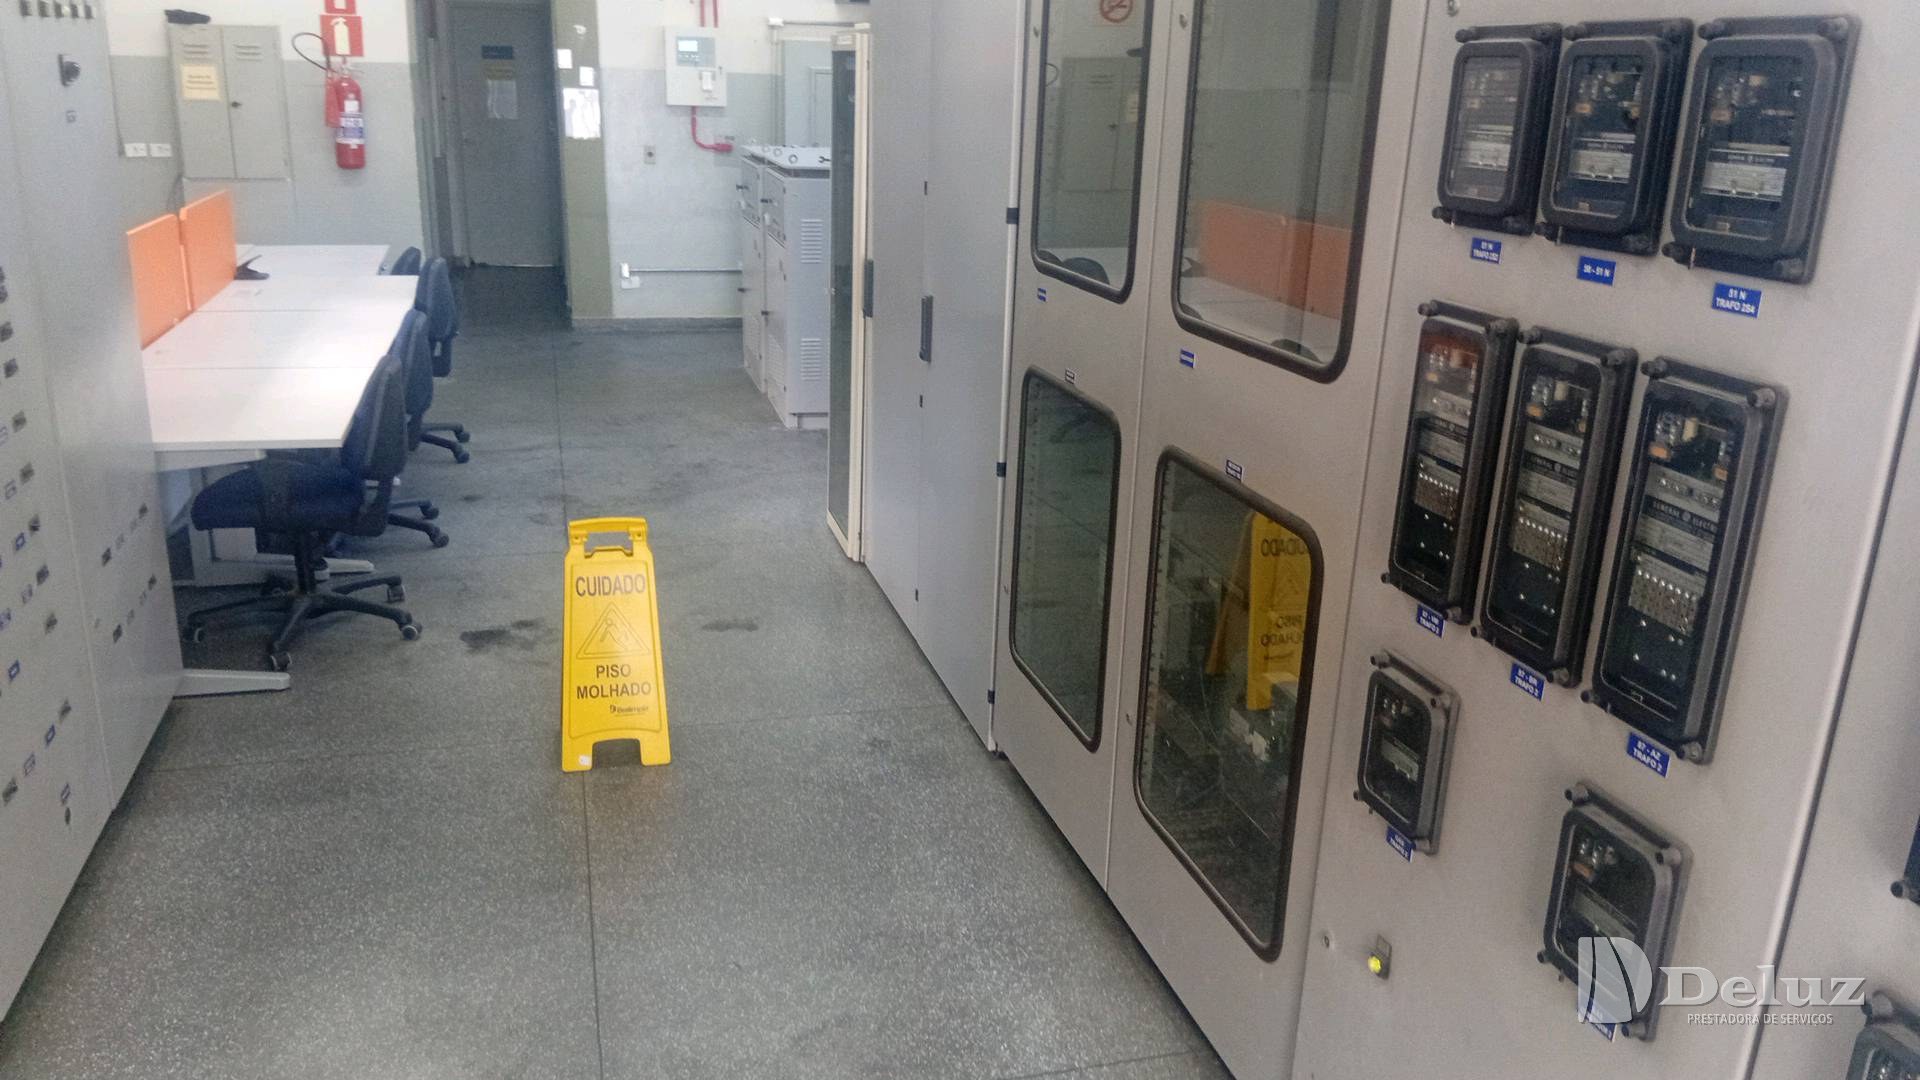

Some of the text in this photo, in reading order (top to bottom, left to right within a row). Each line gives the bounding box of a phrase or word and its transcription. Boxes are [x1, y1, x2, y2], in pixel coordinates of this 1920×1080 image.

[1715, 297, 1741, 311] TRAFO
[1739, 289, 1747, 300] N
[575, 574, 646, 597] CUIDADO
[596, 663, 632, 679] PISO
[576, 681, 652, 700] MOLHADO
[1514, 675, 1534, 694] TRAFO
[1633, 746, 1663, 773] TRAFO 2
